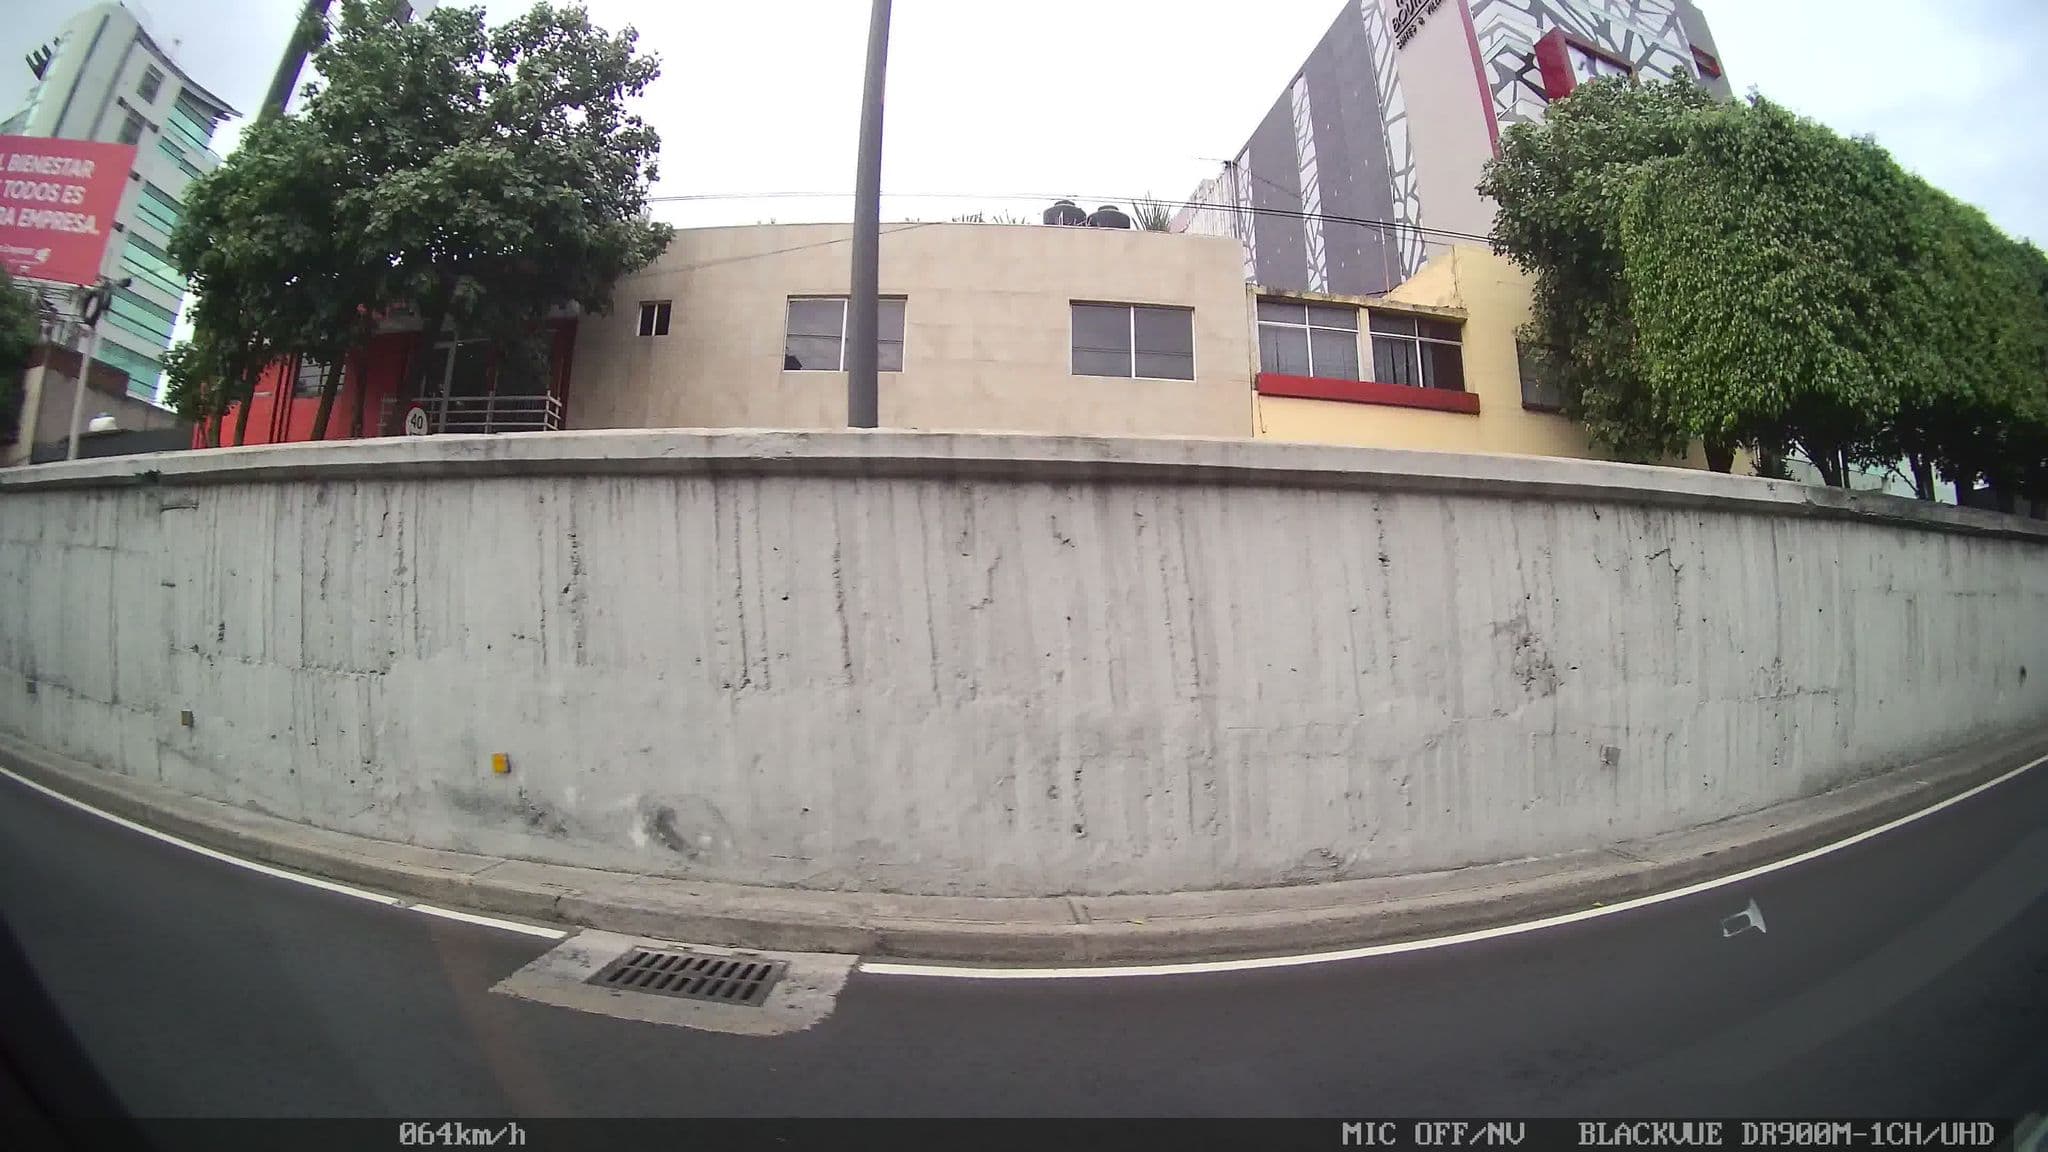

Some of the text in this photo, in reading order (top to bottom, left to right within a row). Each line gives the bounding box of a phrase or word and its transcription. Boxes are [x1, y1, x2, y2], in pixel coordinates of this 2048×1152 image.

[7, 153, 96, 179] BIENESTAR
[3, 180, 86, 204] TODOS ES
[17, 208, 100, 235] EMPRESA.
[411, 413, 423, 429] 40
